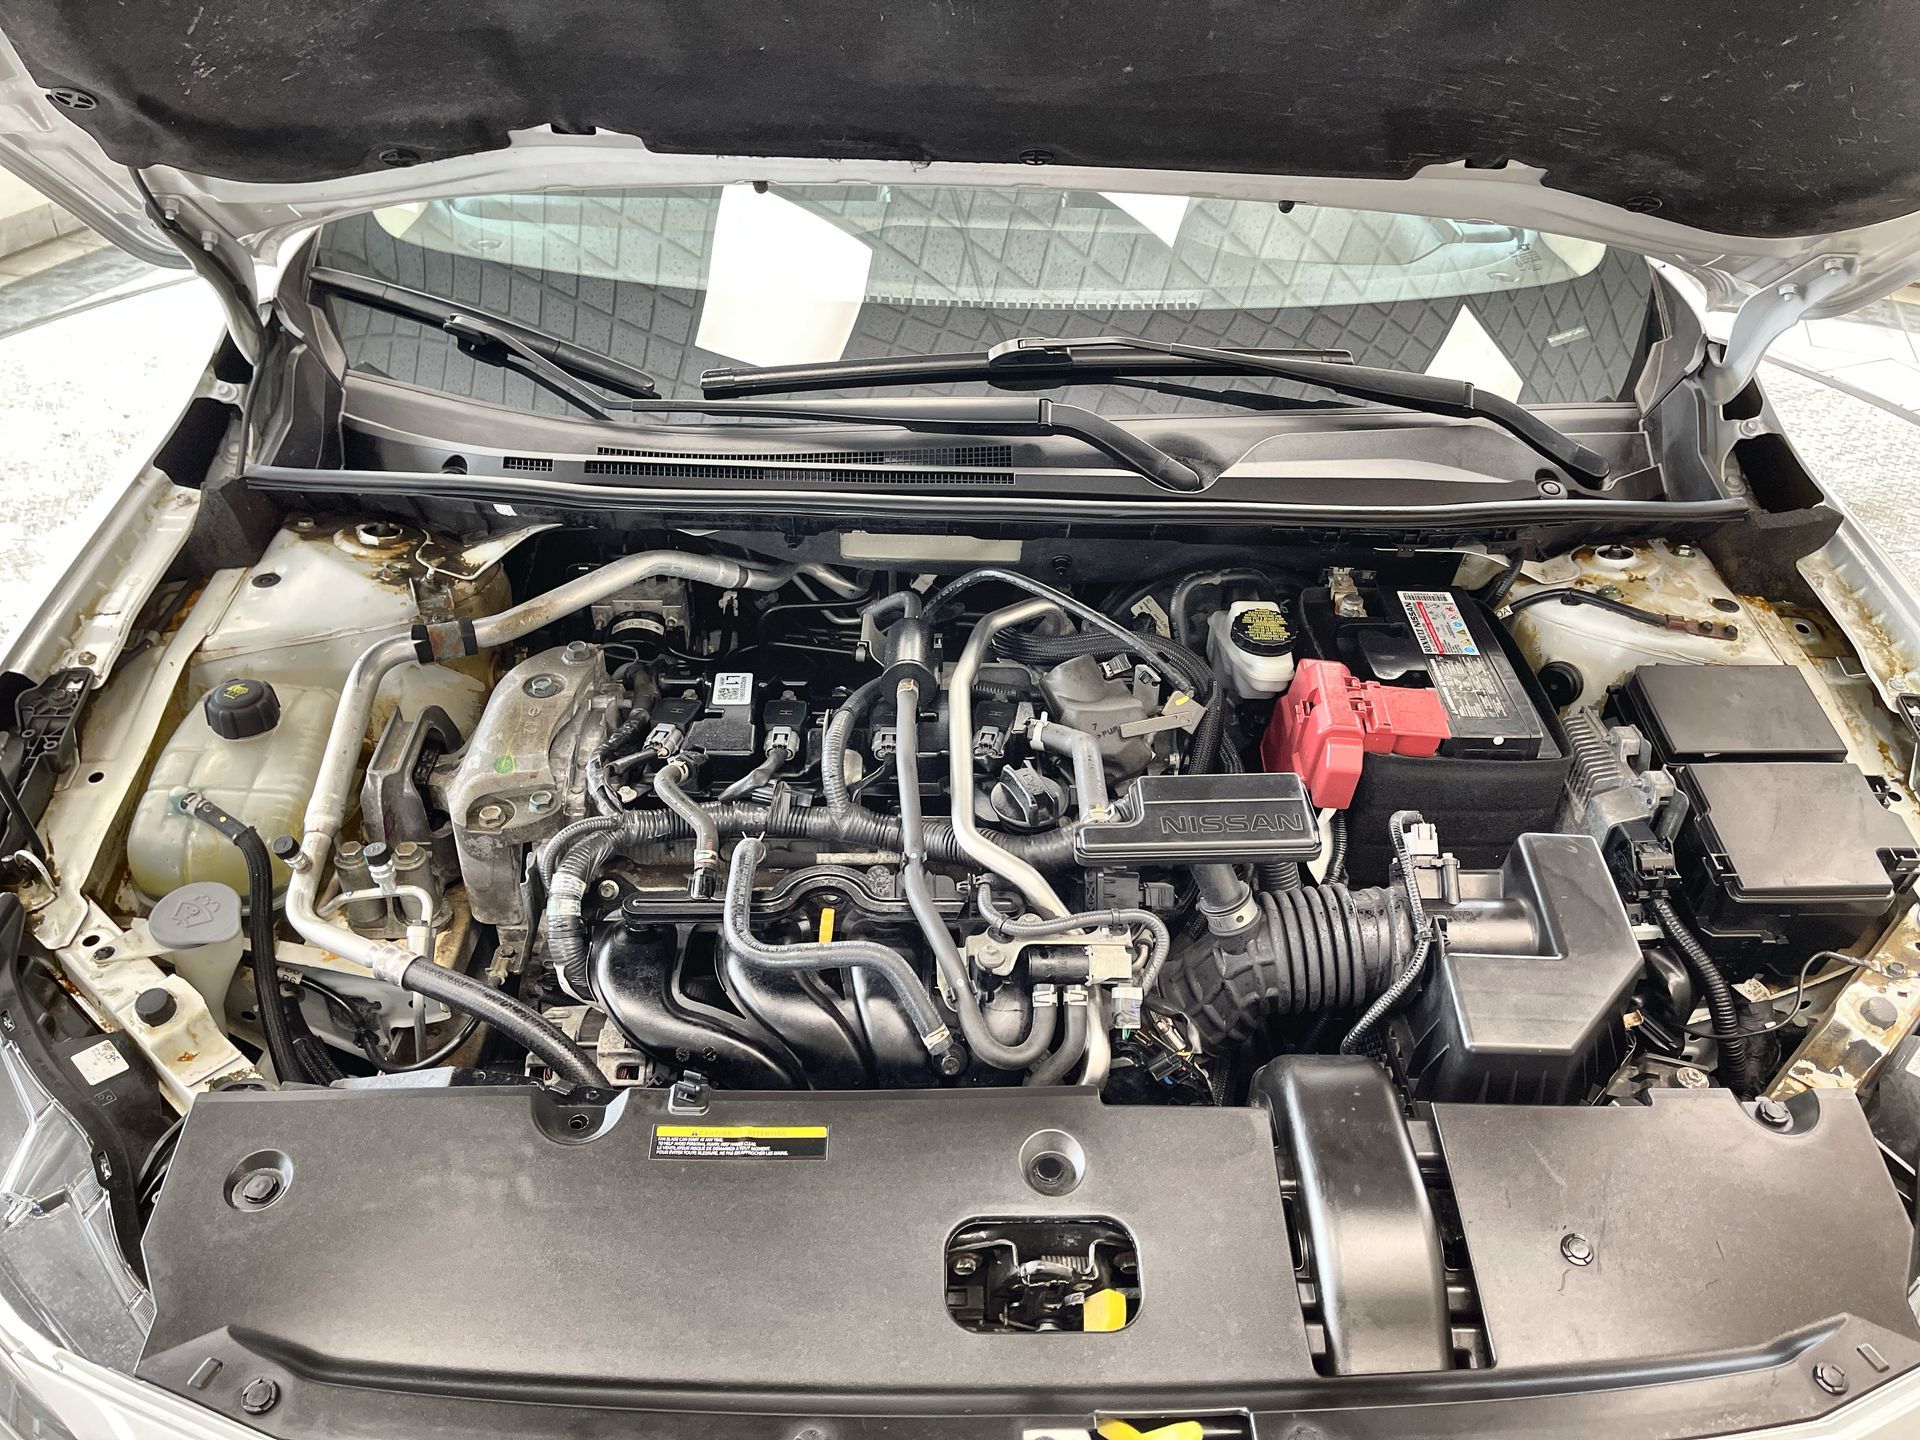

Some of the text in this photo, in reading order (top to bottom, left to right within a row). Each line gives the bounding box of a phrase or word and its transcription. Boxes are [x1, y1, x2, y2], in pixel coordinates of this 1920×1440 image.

[1404, 602, 1421, 628] NISSAN
[1415, 629, 1432, 653] RENAULT
[725, 675, 740, 685] L1
[1160, 813, 1304, 834] NISSAN
